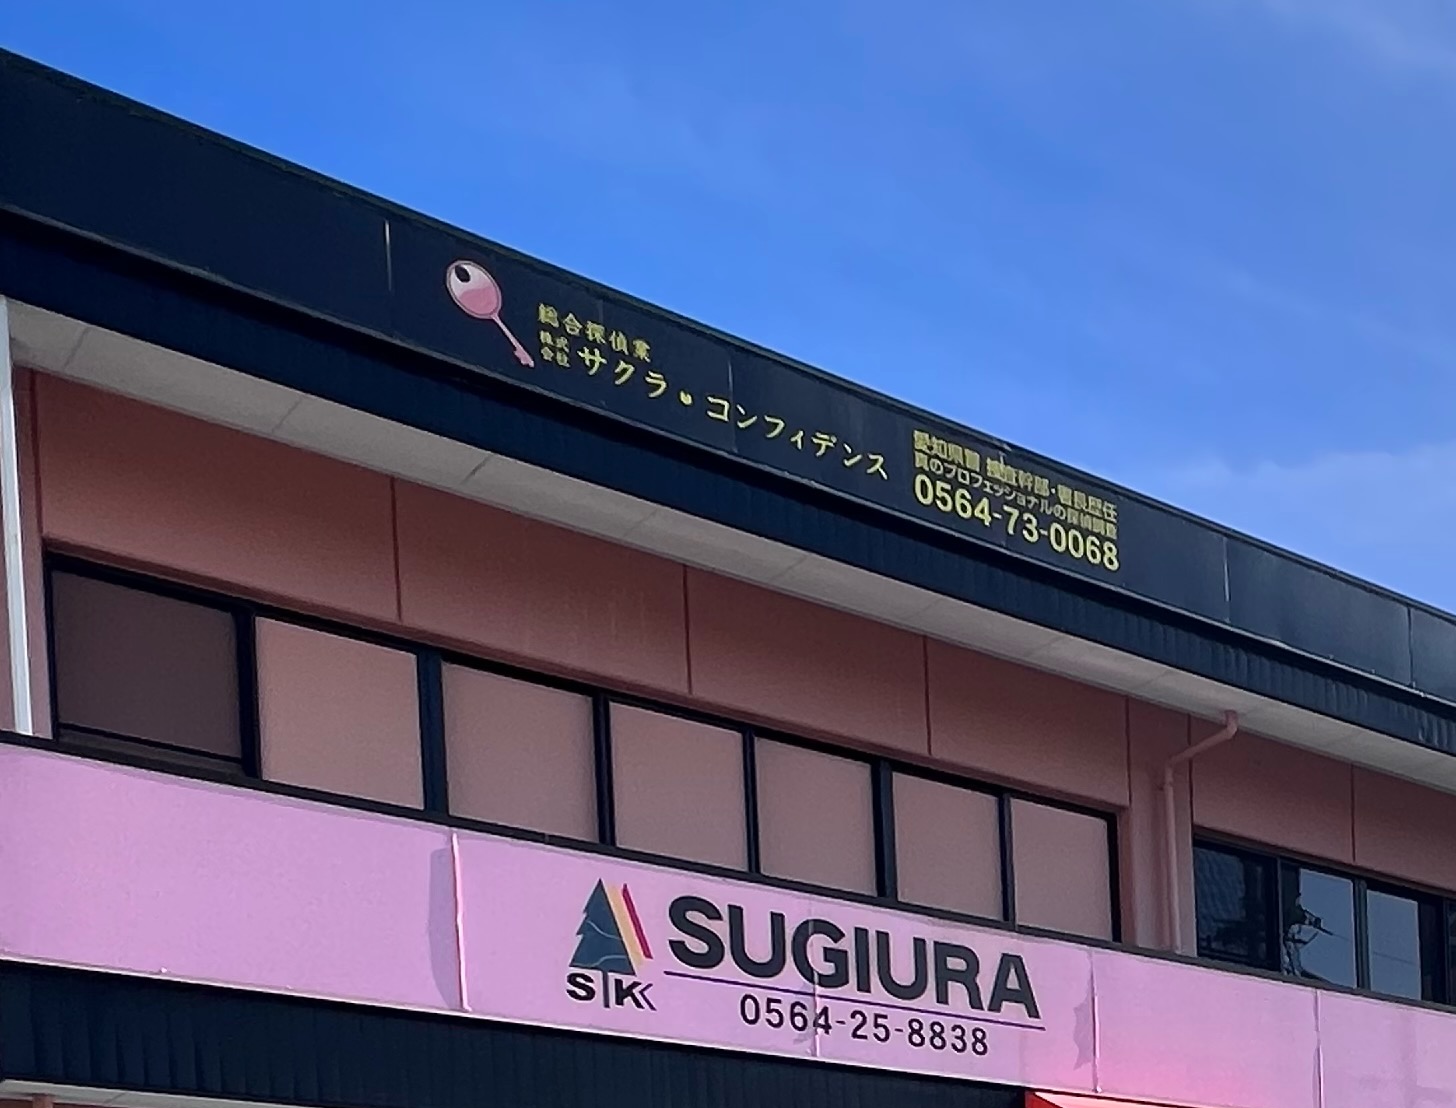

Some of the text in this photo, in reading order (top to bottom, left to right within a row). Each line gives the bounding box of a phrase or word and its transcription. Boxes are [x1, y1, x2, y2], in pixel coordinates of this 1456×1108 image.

[914, 474, 1120, 572] 0564-73-0068
[668, 896, 1041, 1020] SUGIURA
[740, 993, 989, 1056] 0564-25-8838
